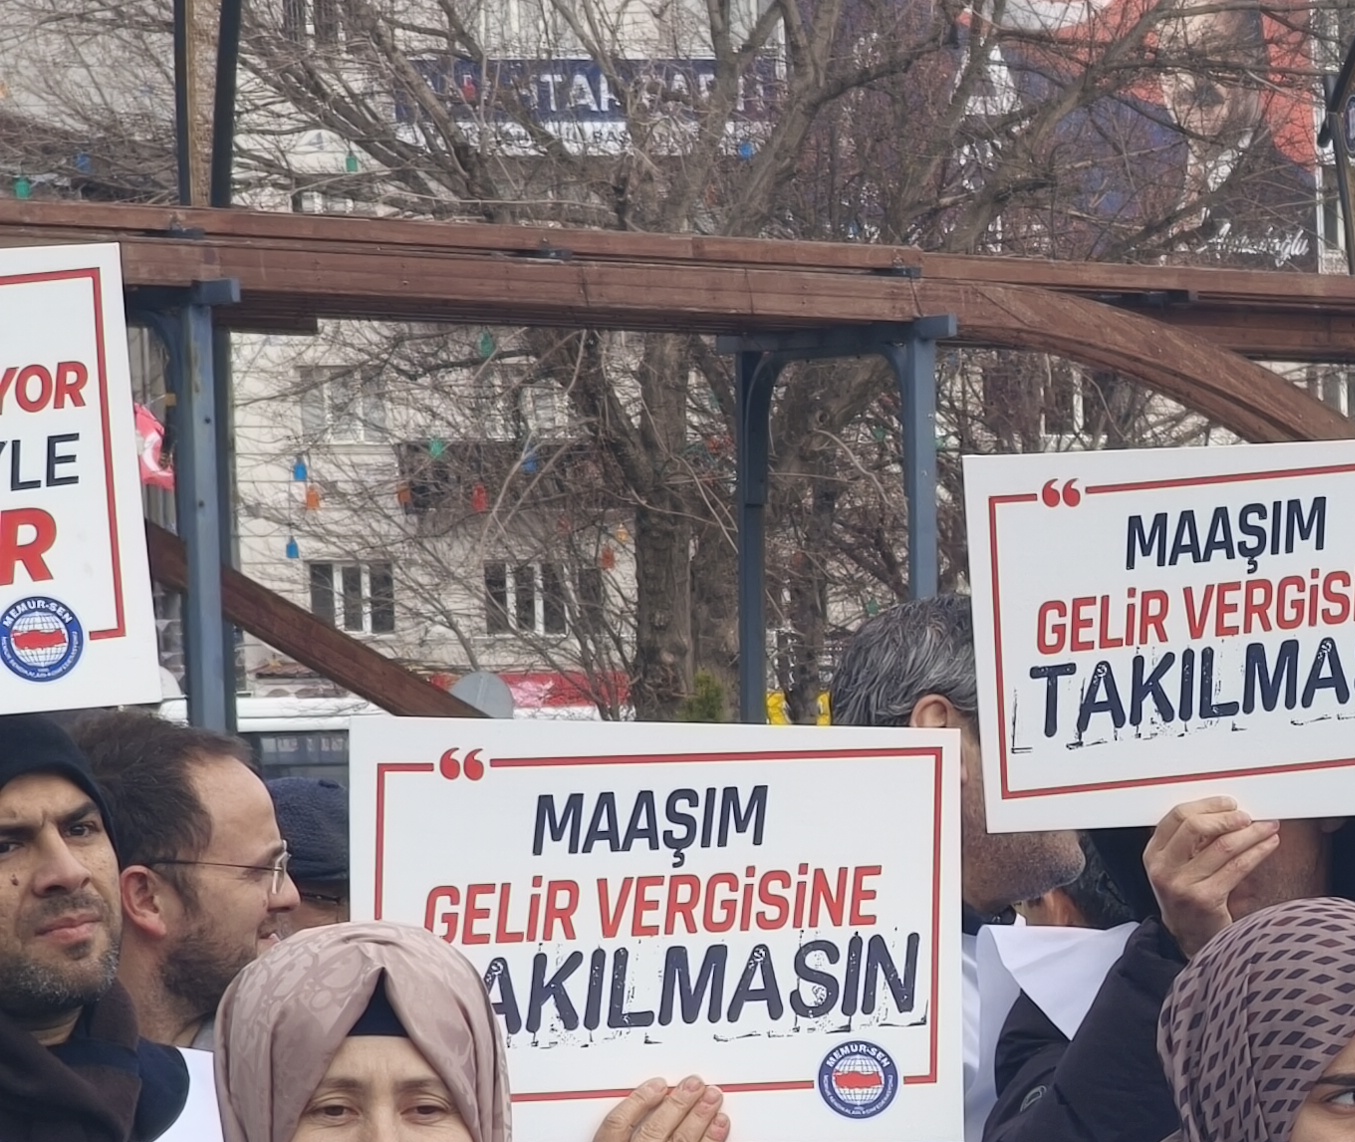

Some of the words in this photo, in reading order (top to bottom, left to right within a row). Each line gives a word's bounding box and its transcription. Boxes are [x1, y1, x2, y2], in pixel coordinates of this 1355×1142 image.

[0, 433, 80, 491] LE
[1126, 496, 1326, 574] MAAŞIM
[3, 600, 73, 627] MEMUR-SEN
[1037, 588, 1168, 654] GELİR
[533, 785, 768, 868] MAAŞIM
[424, 876, 579, 945] GELİR
[597, 863, 881, 938] VERGİSİNE
[484, 932, 920, 1033] AKILMASIN
[826, 1044, 890, 1068] MEMUR-SEN
